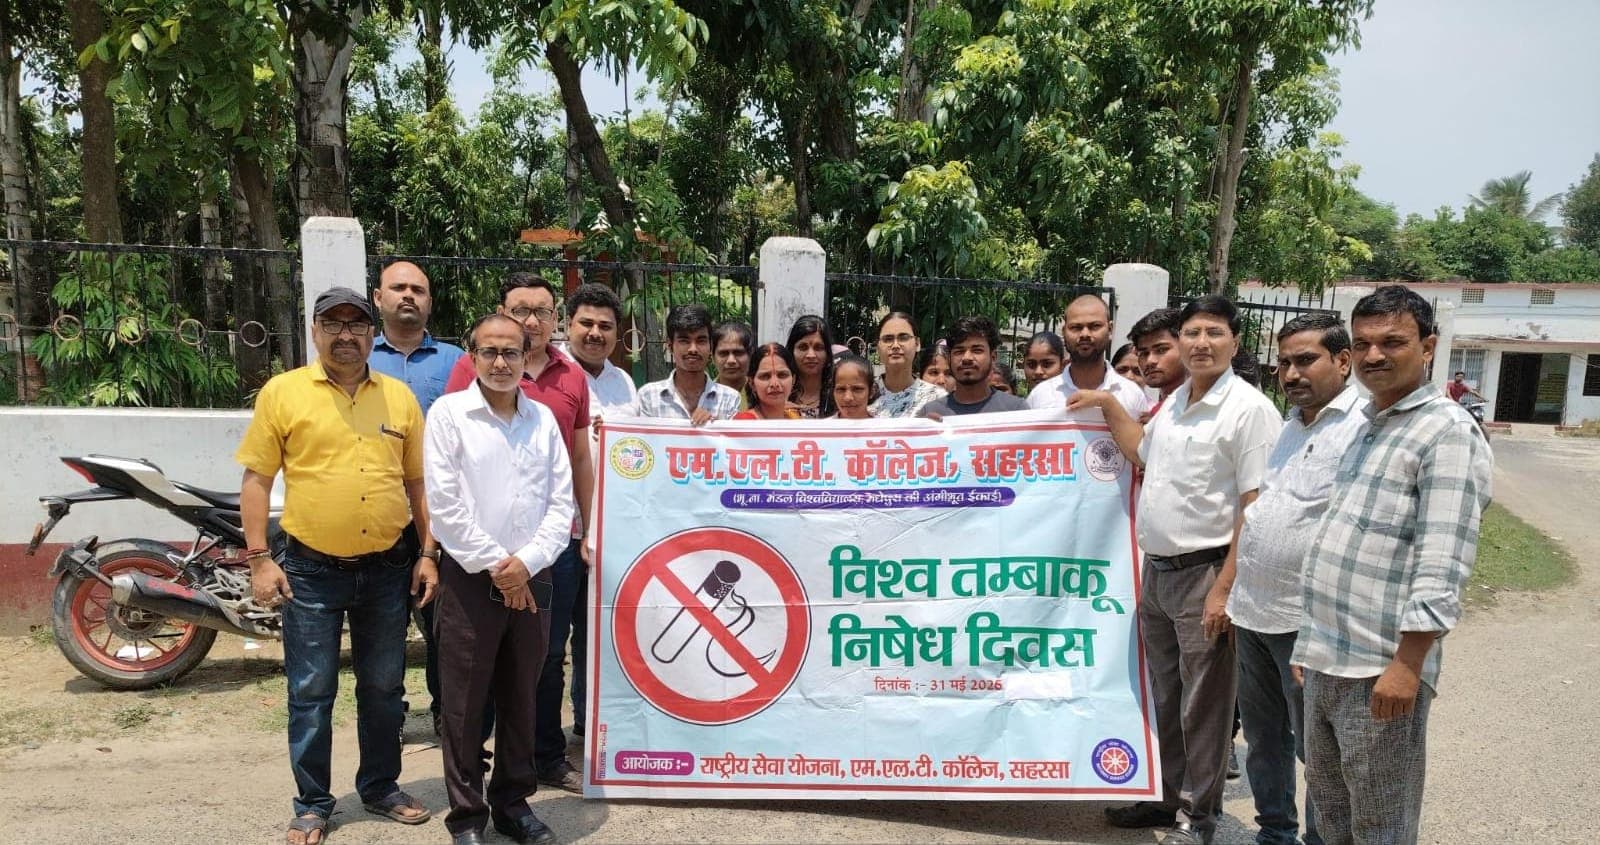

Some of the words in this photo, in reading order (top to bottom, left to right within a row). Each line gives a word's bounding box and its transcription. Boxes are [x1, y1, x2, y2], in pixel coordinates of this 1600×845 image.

[665, 440, 834, 482] एम.एल.टी.
[844, 439, 959, 482] कॉलेज,
[969, 442, 1076, 480] सहरसा
[766, 491, 793, 504] मंडल
[904, 490, 920, 503] की
[828, 544, 942, 599] विश्व
[949, 555, 1125, 615] तम्बाकू
[828, 612, 957, 667] निषेध
[965, 611, 1098, 668] दिवस
[874, 676, 911, 691] दिनांक
[930, 679, 945, 691] 31
[950, 676, 966, 693] मई
[621, 755, 673, 771] आयोजक
[700, 752, 749, 780] राष्ट्रीय
[752, 752, 784, 776] सेवा
[788, 753, 846, 779] योजना,
[850, 754, 937, 778] एम.एल.टी.
[942, 755, 1004, 780] कॉलेज,
[1009, 760, 1071, 780] सहरसा
